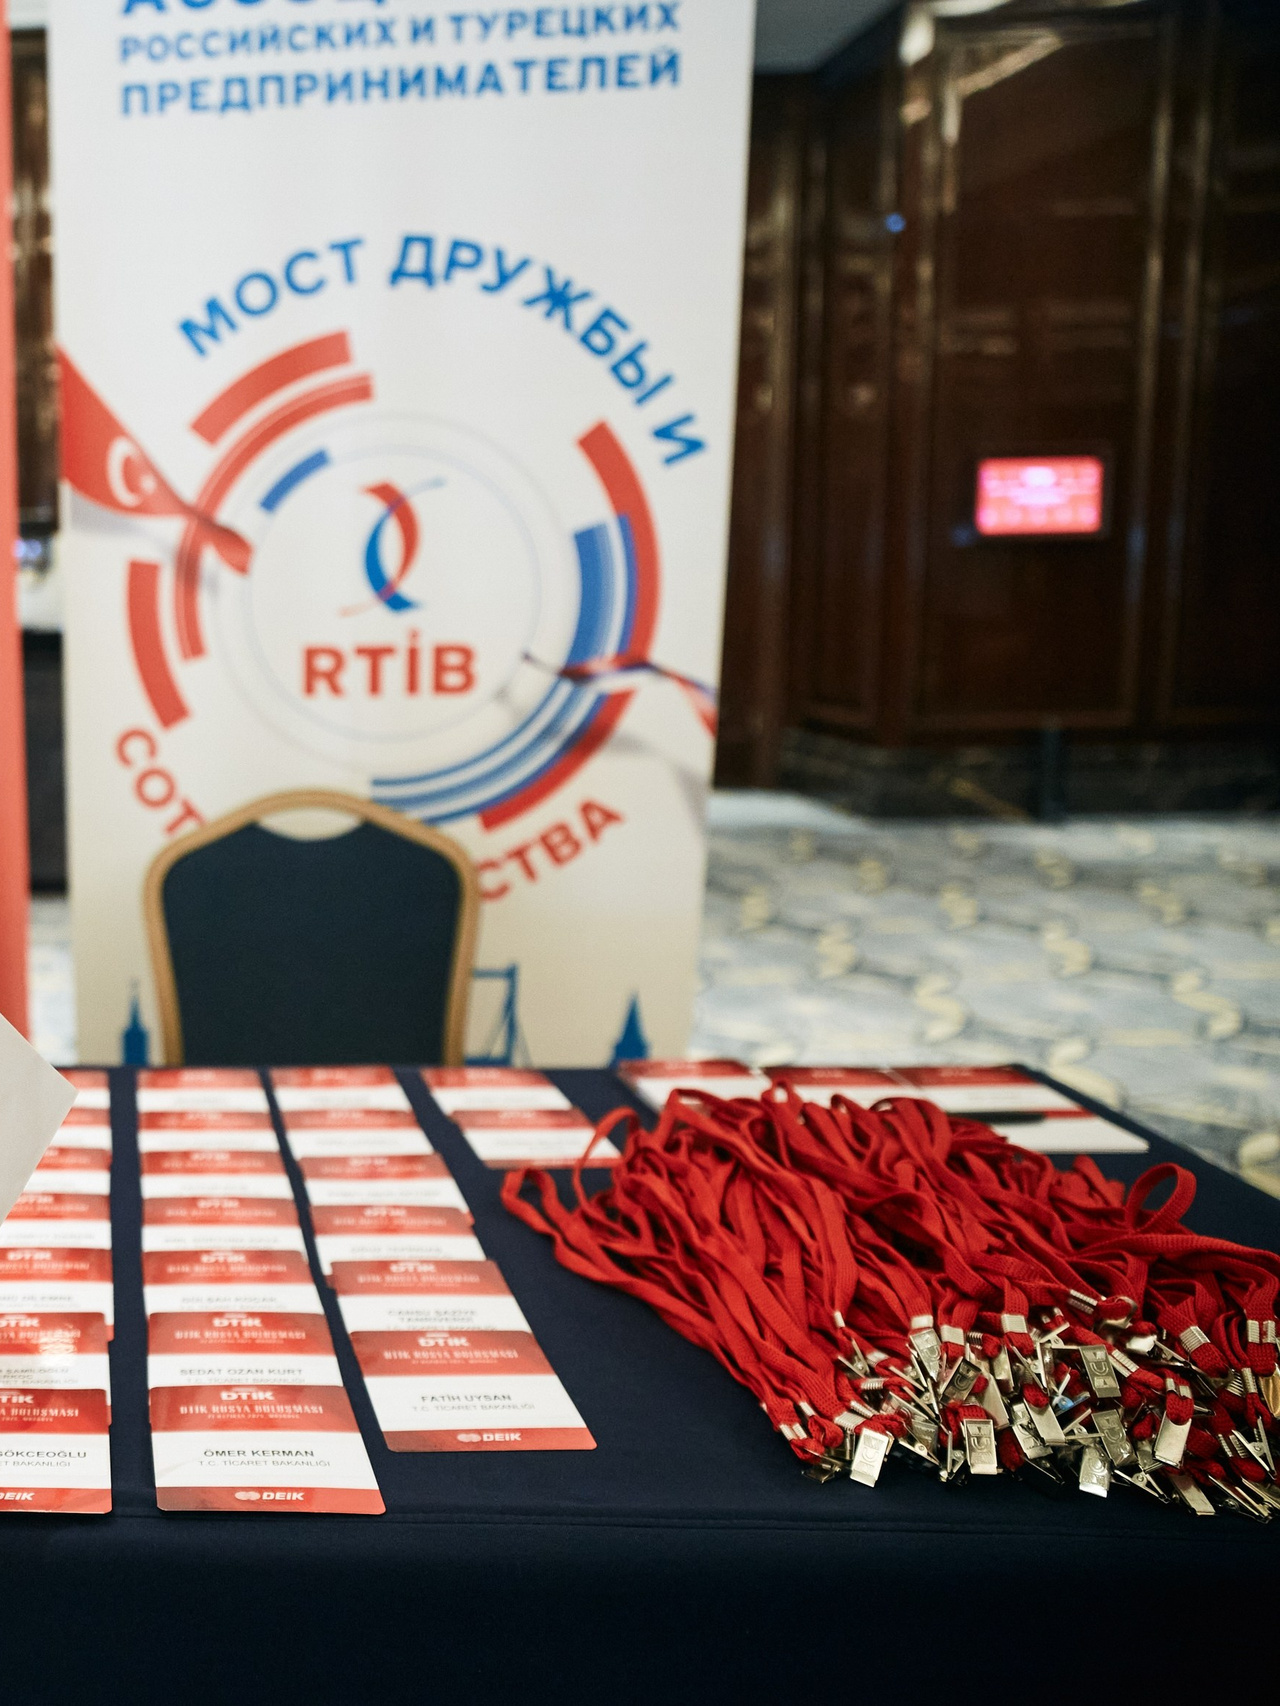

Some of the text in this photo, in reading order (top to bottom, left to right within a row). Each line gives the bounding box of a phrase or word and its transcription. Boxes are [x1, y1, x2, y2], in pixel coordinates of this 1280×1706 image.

[120, 1, 681, 63] РОССИЙСКИХ И ТУРЕЦКИХ
[121, 47, 681, 117] ПРЕДПРИНИМАТЕЛЕЙ
[179, 233, 708, 467] МОСТ ДРУЖБЫ И
[301, 629, 477, 698] RTİB
[203, 1448, 315, 1457] ÖMER KERMAN
